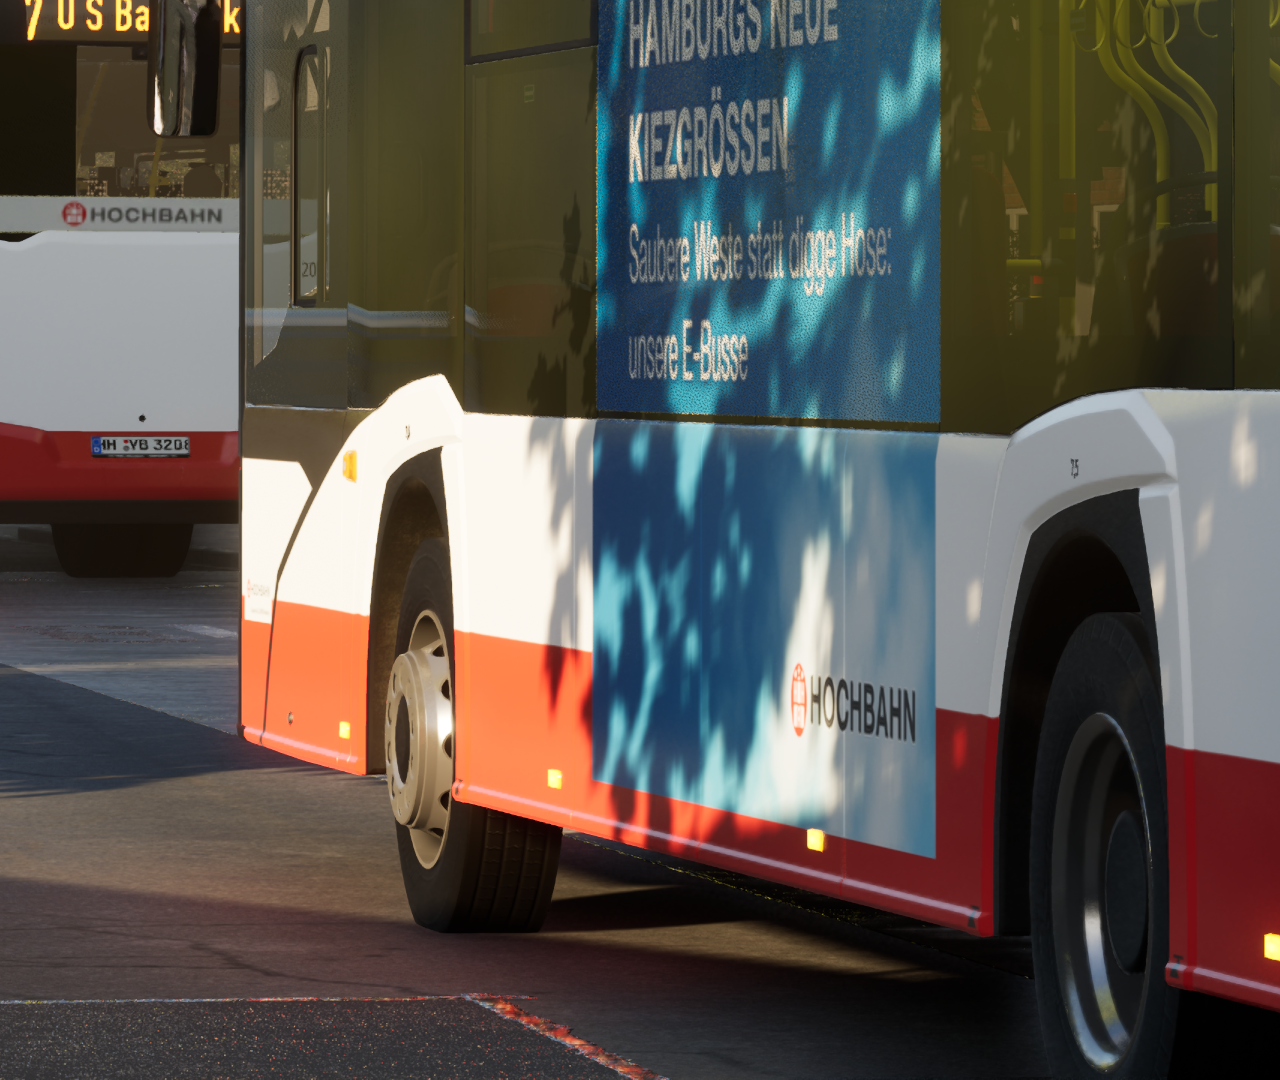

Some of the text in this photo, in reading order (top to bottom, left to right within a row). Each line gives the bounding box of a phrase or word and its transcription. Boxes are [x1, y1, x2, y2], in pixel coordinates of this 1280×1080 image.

[629, 86, 789, 183] KIEZGRÖSSEN
[90, 207, 223, 224] HOCHBAHN
[629, 212, 891, 296] Saubere Weste statt digge Hose:
[629, 319, 748, 381] unsere E-Busse
[810, 675, 916, 744] HOCHBAHN
